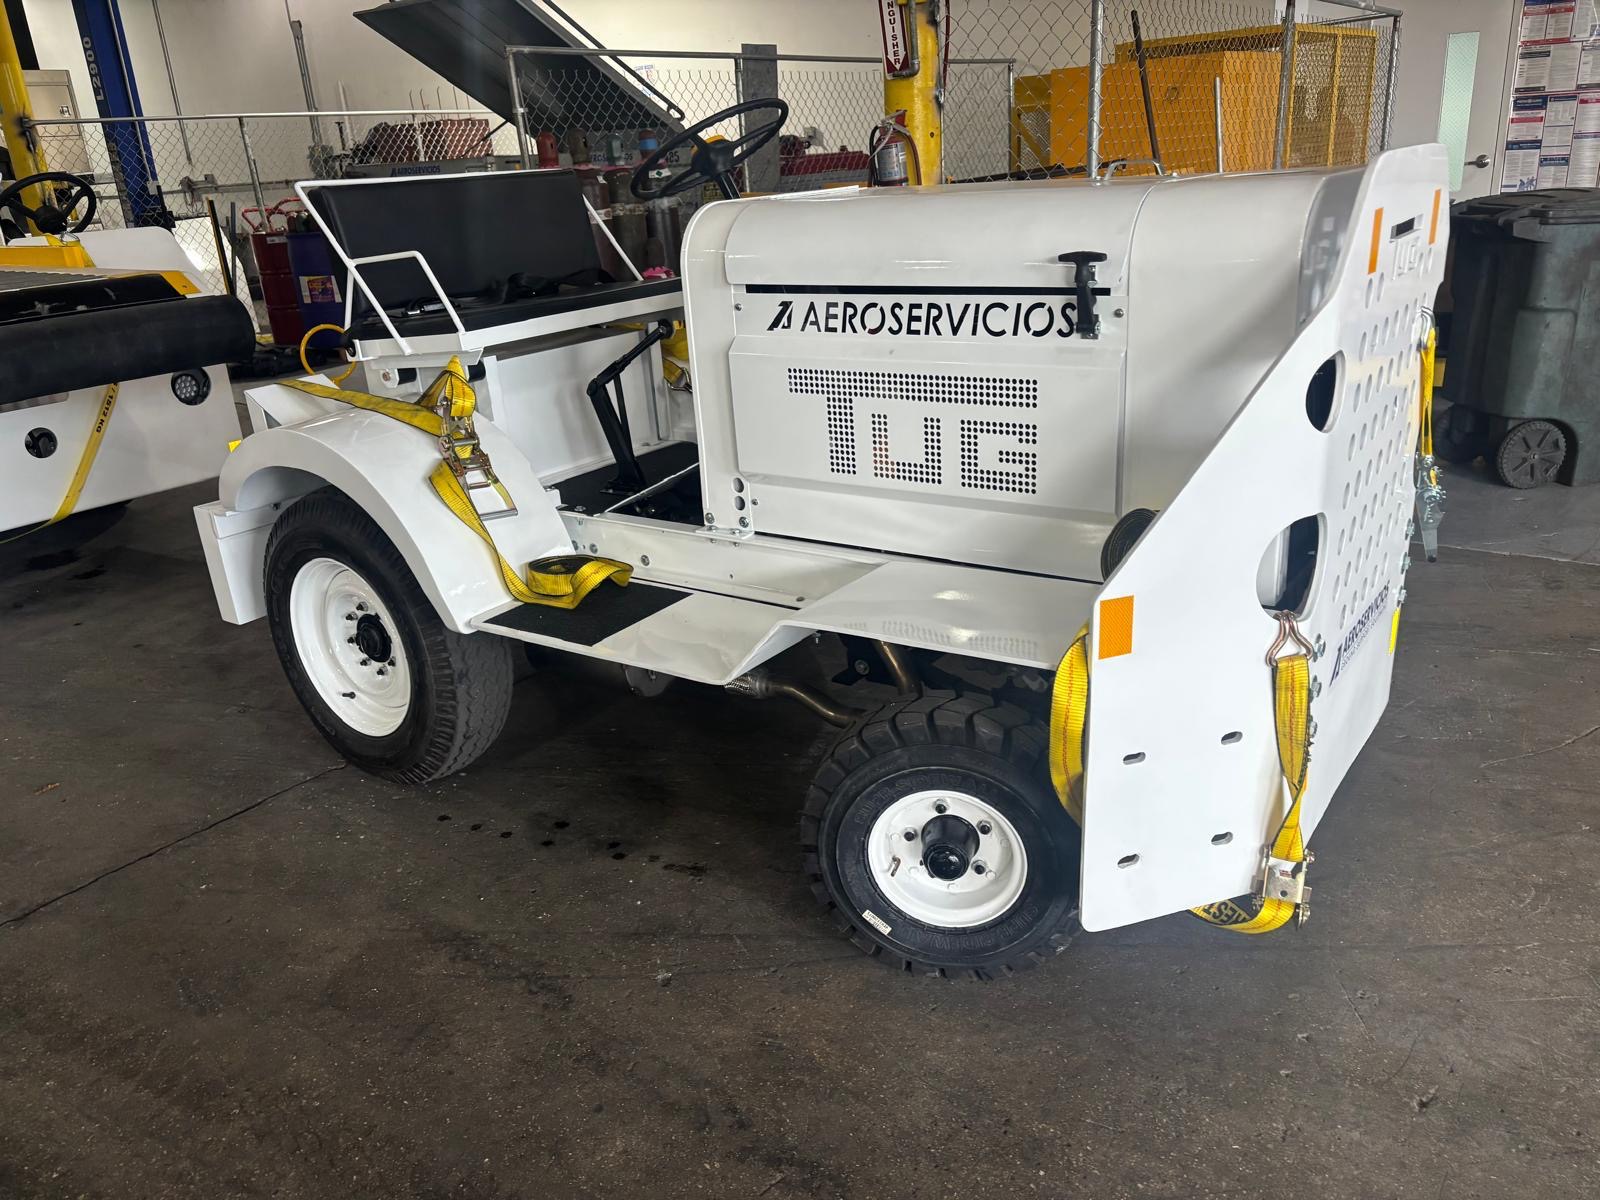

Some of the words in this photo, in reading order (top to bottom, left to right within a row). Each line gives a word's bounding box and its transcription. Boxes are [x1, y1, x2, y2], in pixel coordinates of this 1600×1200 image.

[83, 36, 104, 101] L2900
[799, 301, 1077, 338] AEROSERVICIOS
[787, 366, 1038, 495] TUG
